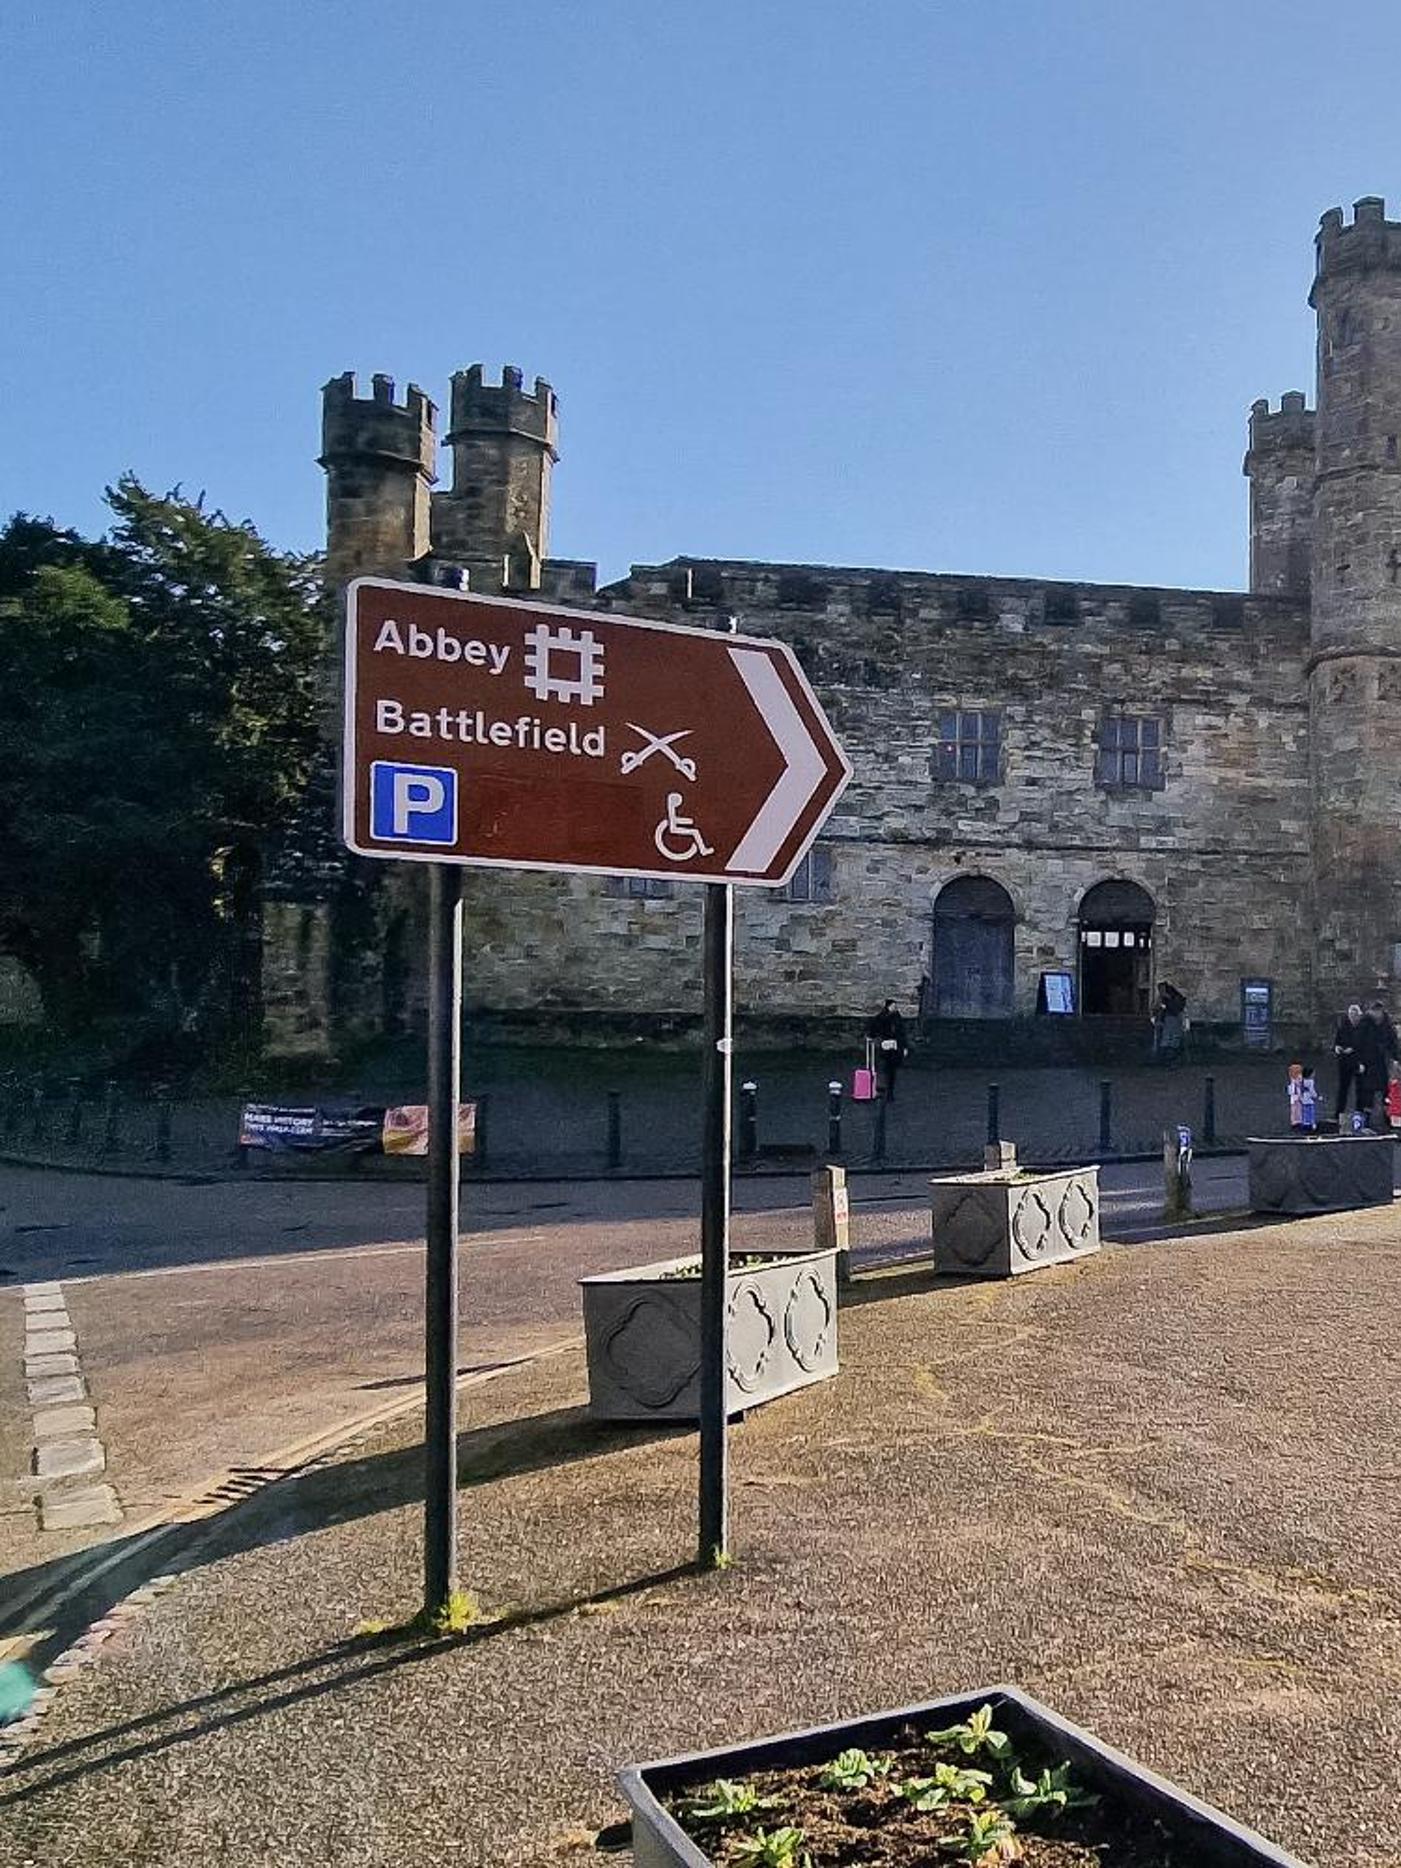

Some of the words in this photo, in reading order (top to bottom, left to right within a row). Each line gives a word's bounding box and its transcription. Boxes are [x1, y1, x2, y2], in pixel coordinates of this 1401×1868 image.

[373, 619, 511, 675] Abbey
[376, 700, 606, 756] Battlefield
[393, 772, 446, 834] P
